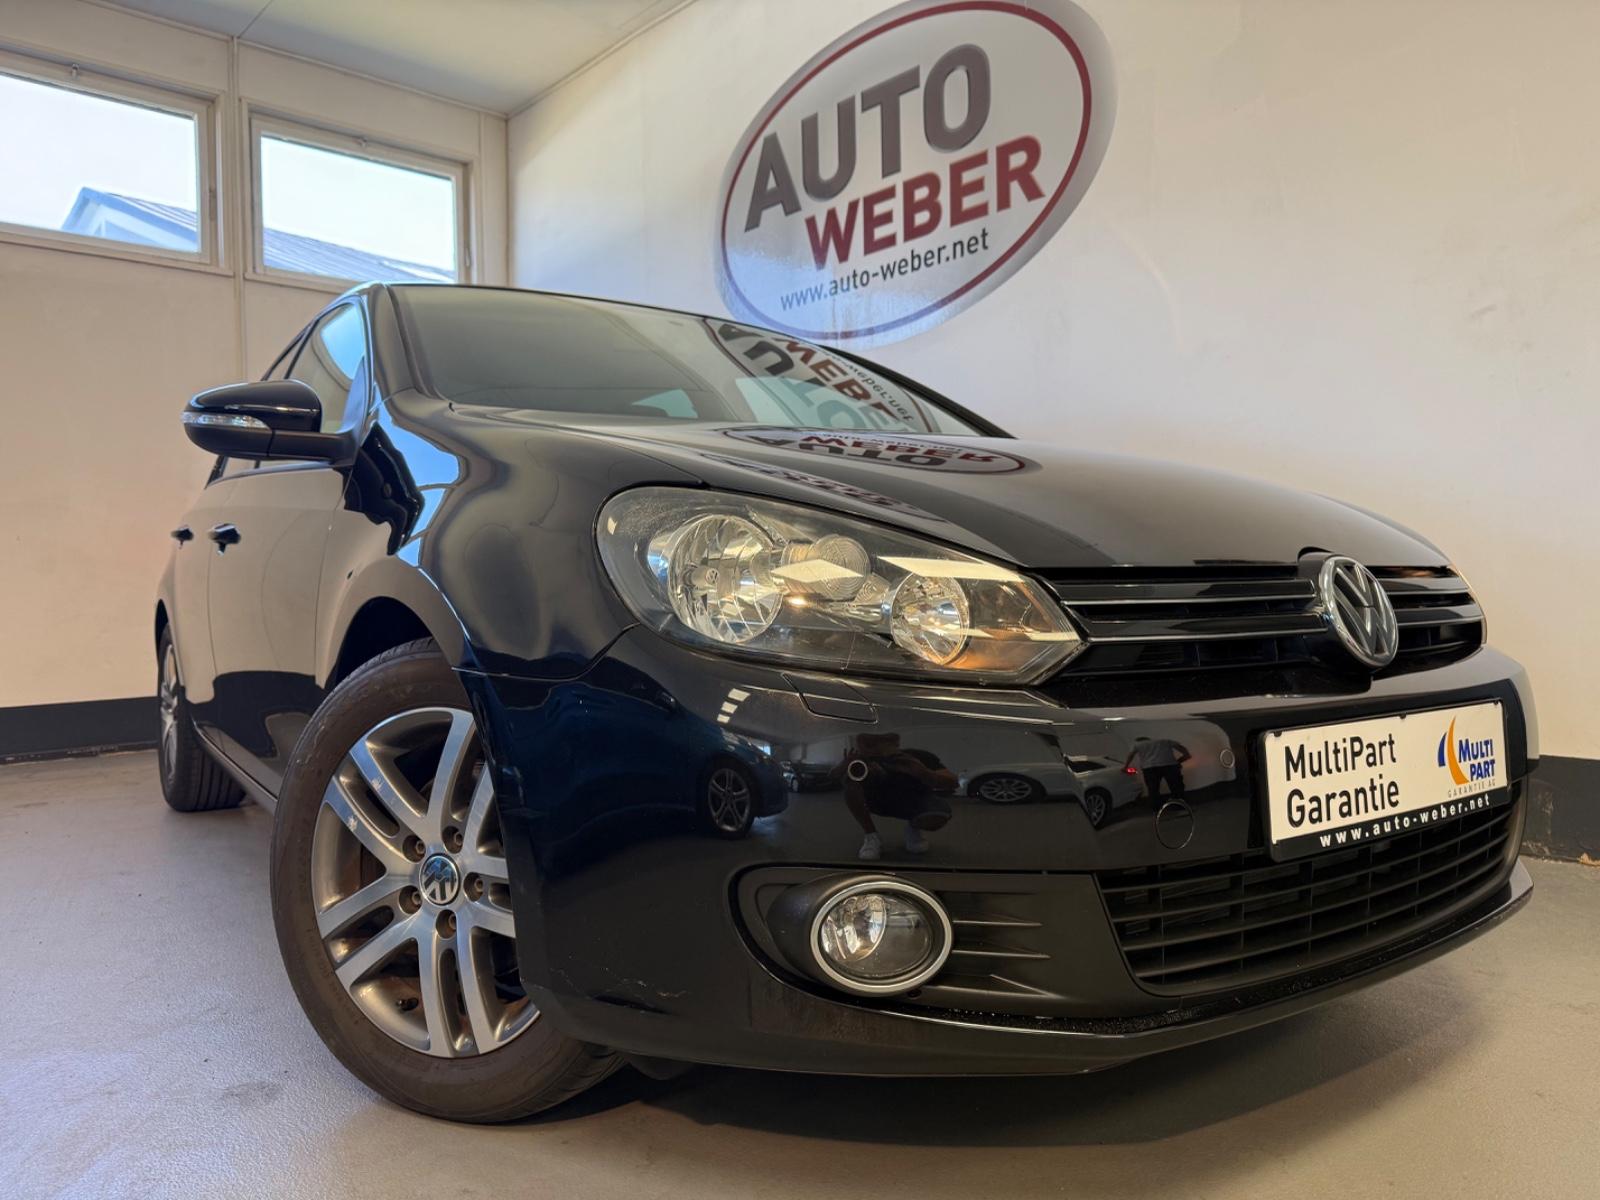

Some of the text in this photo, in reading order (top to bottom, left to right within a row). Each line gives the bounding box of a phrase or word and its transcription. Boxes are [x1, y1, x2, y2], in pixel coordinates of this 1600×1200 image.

[744, 43, 991, 233] AUTO
[804, 135, 1045, 271] WEBER
[780, 228, 989, 311] www.auto-weber.net
[1284, 733, 1397, 781] MultiPart
[1458, 738, 1494, 763] MULTI
[1469, 758, 1496, 782] PART
[1286, 773, 1400, 828] Garantie
[1447, 782, 1485, 799] GARANTIE
[1319, 793, 1490, 848] www.auto-weber.net
